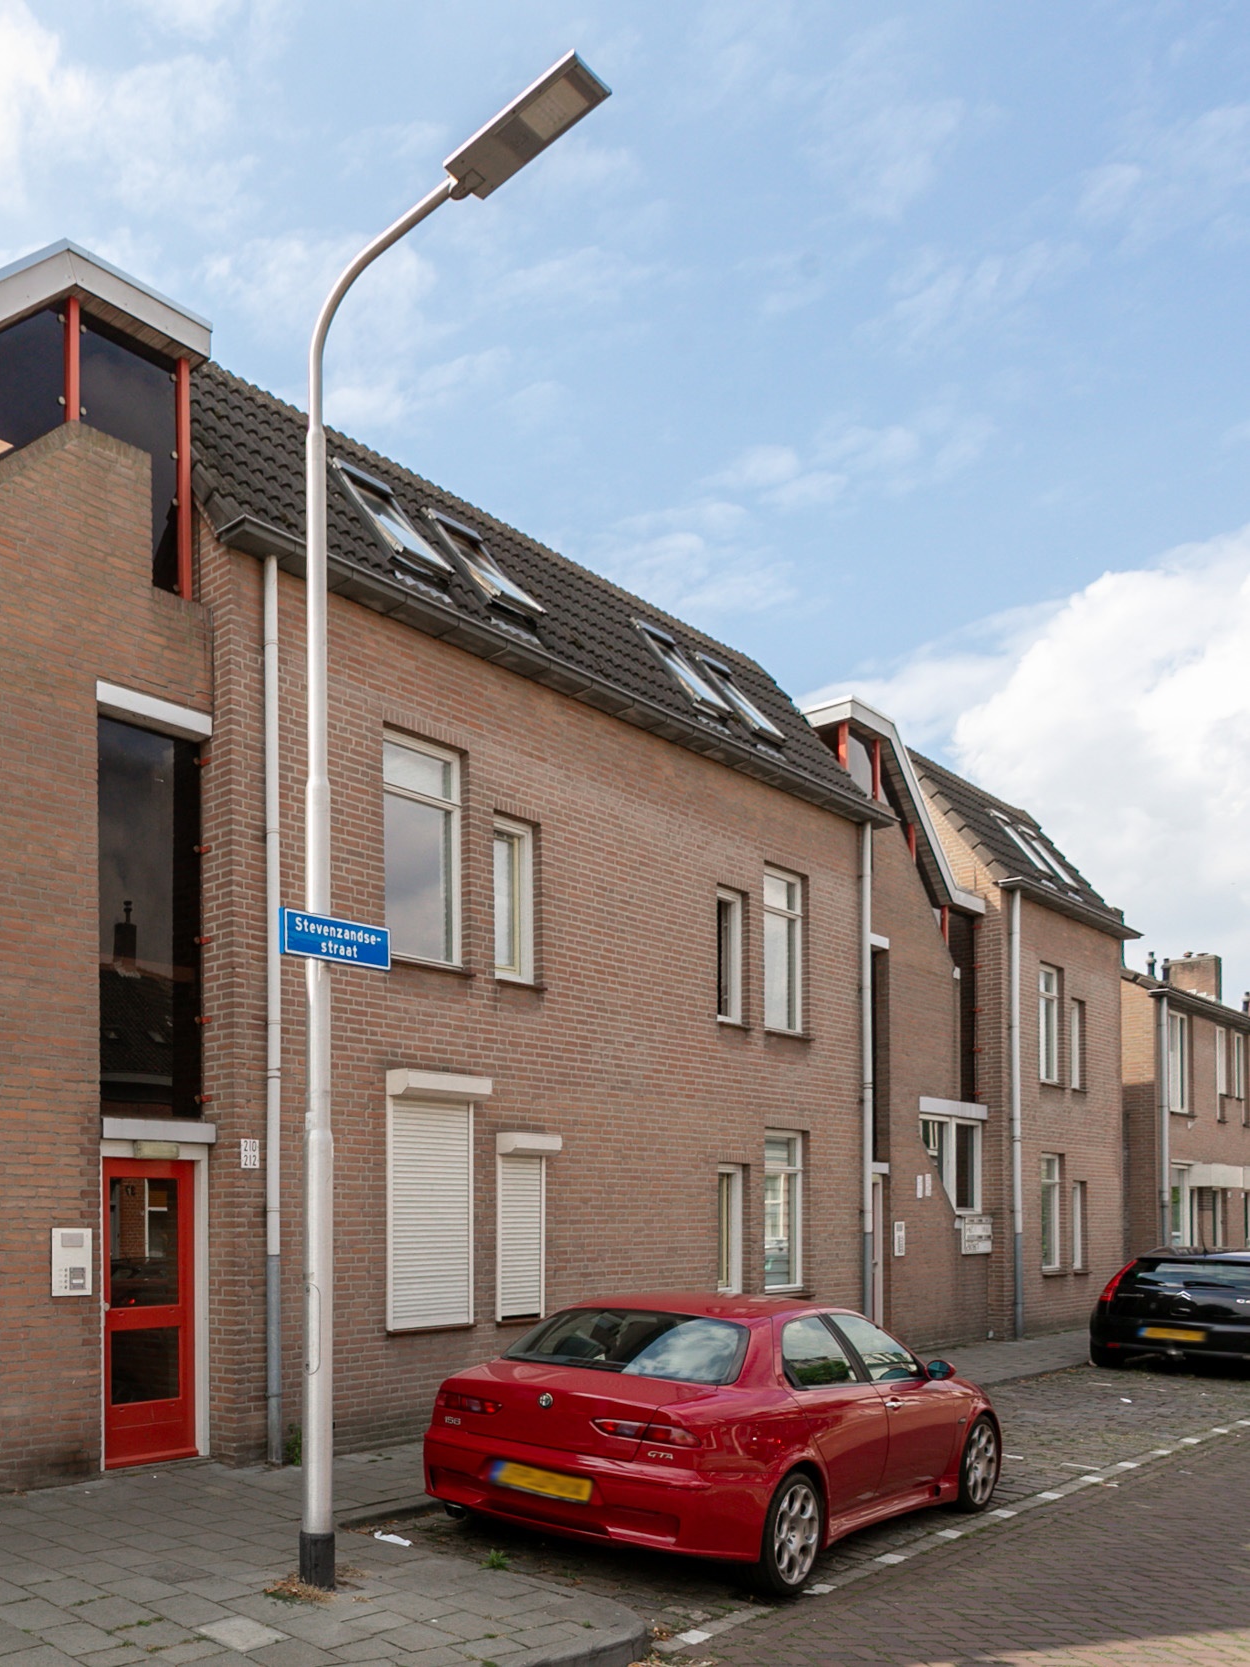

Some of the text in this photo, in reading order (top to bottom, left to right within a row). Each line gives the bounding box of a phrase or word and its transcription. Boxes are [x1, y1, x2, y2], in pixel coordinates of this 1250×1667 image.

[295, 916, 382, 945] Stevenzandse-
[321, 940, 358, 958] straat
[243, 1140, 257, 1152] 210
[243, 1154, 257, 1167] 212
[444, 1415, 462, 1426] 156
[647, 1450, 673, 1460] GTA
